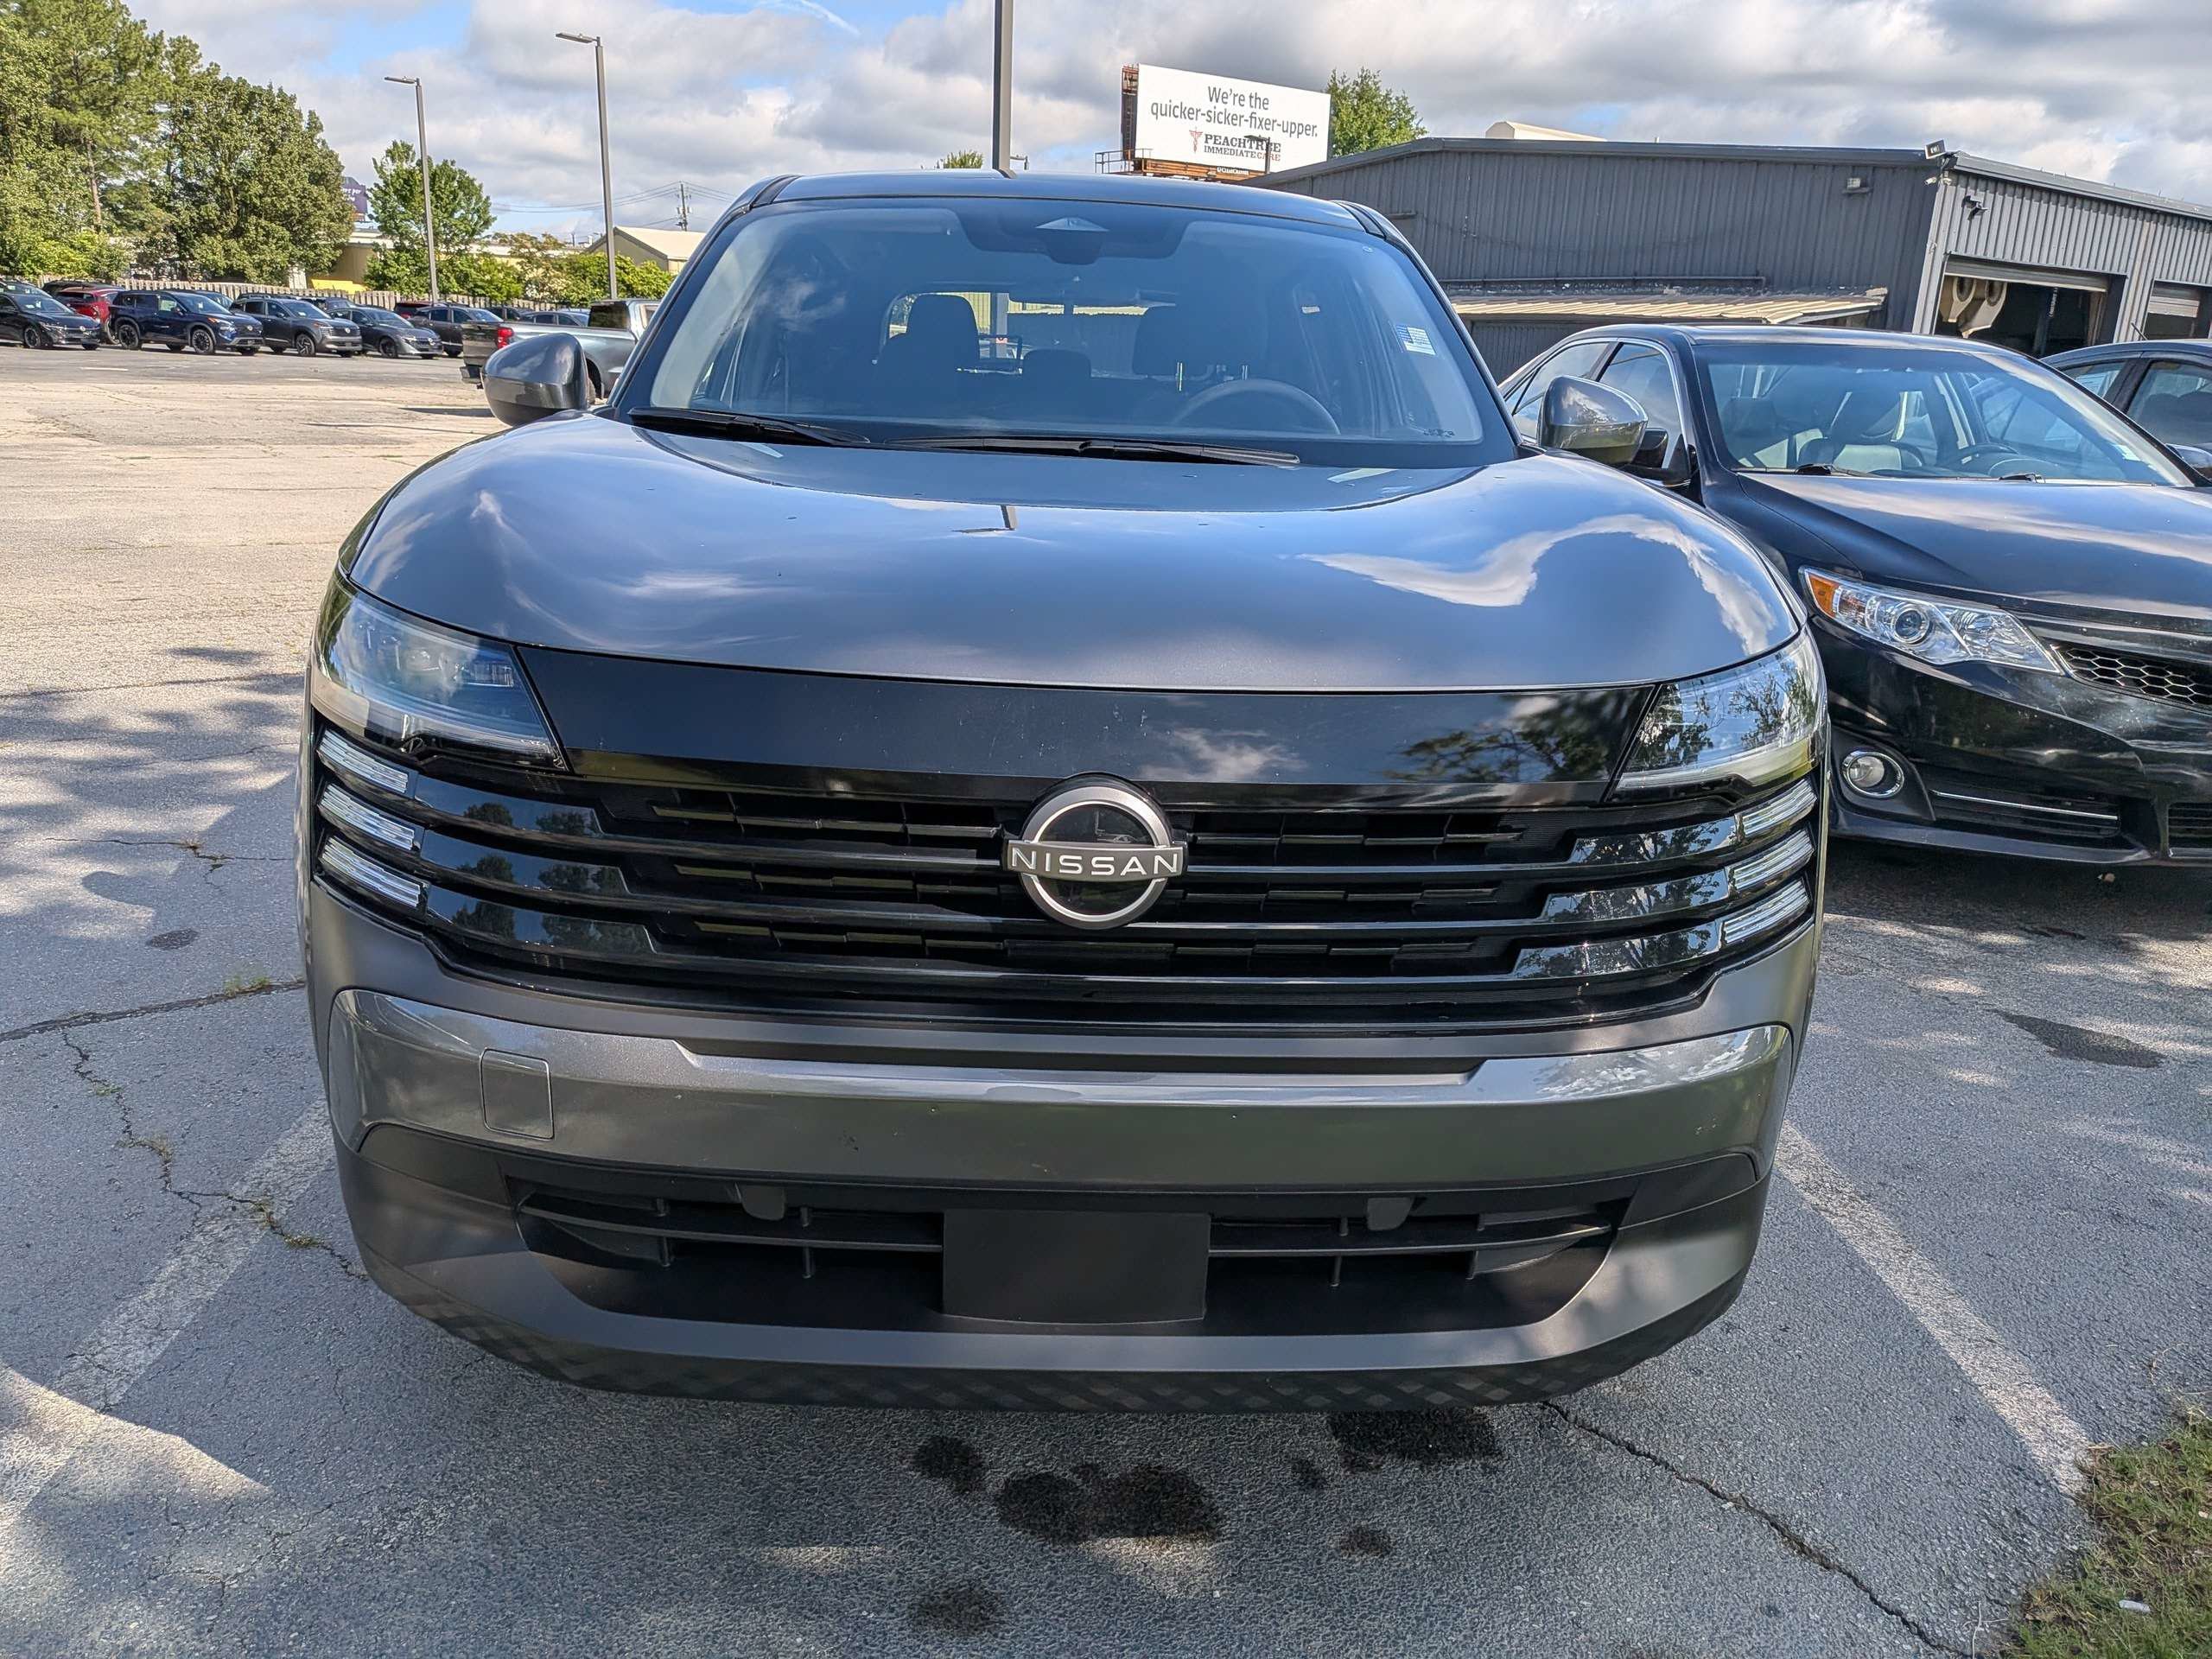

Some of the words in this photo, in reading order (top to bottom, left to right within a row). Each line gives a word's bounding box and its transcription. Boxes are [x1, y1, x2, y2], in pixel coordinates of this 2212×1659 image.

[1208, 86, 1246, 107] We’re
[1249, 92, 1269, 111] the
[1151, 99, 1318, 138] quicker-sicker-fixer-upper.
[1012, 847, 1179, 876] NISSAN
